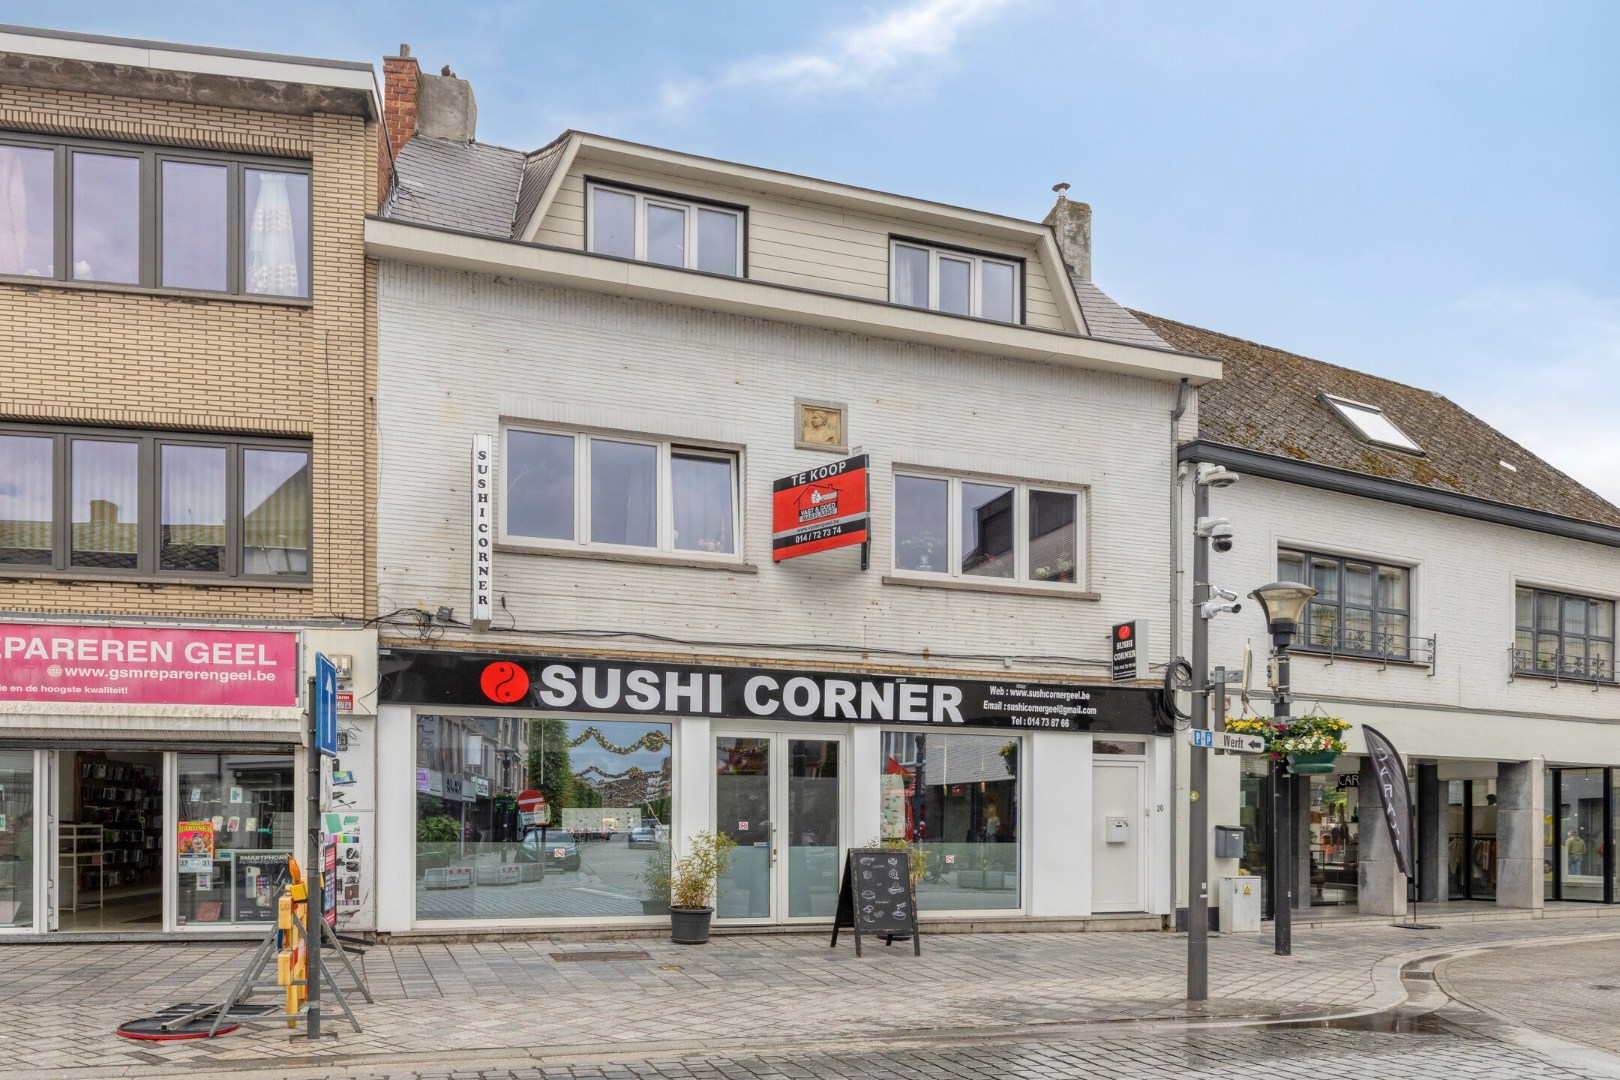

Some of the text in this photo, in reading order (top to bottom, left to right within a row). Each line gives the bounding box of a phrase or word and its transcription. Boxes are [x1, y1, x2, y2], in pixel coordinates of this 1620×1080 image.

[791, 461, 847, 486] TE KOOP
[795, 534, 808, 543] 014
[813, 530, 822, 540] 72
[823, 528, 831, 537] 73
[833, 526, 842, 535] 74
[0, 637, 277, 665] PAREREN GEEL
[1116, 640, 1133, 650] SUSHI
[1113, 649, 1136, 661] CORNER
[65, 667, 276, 683] www.gsmreparerengeel.be
[41, 685, 82, 694] hoogste
[84, 686, 129, 694] kwaliteit!
[539, 664, 965, 723] SUSHI CORNER
[1009, 688, 1091, 701] www.sushicornergeel.be
[1007, 703, 1097, 715] sushicornergeel@gmail.com
[1027, 718, 1040, 726] 014
[1041, 718, 1050, 726] 73
[1223, 734, 1244, 749] Werft
[1156, 804, 1164, 812] 20
